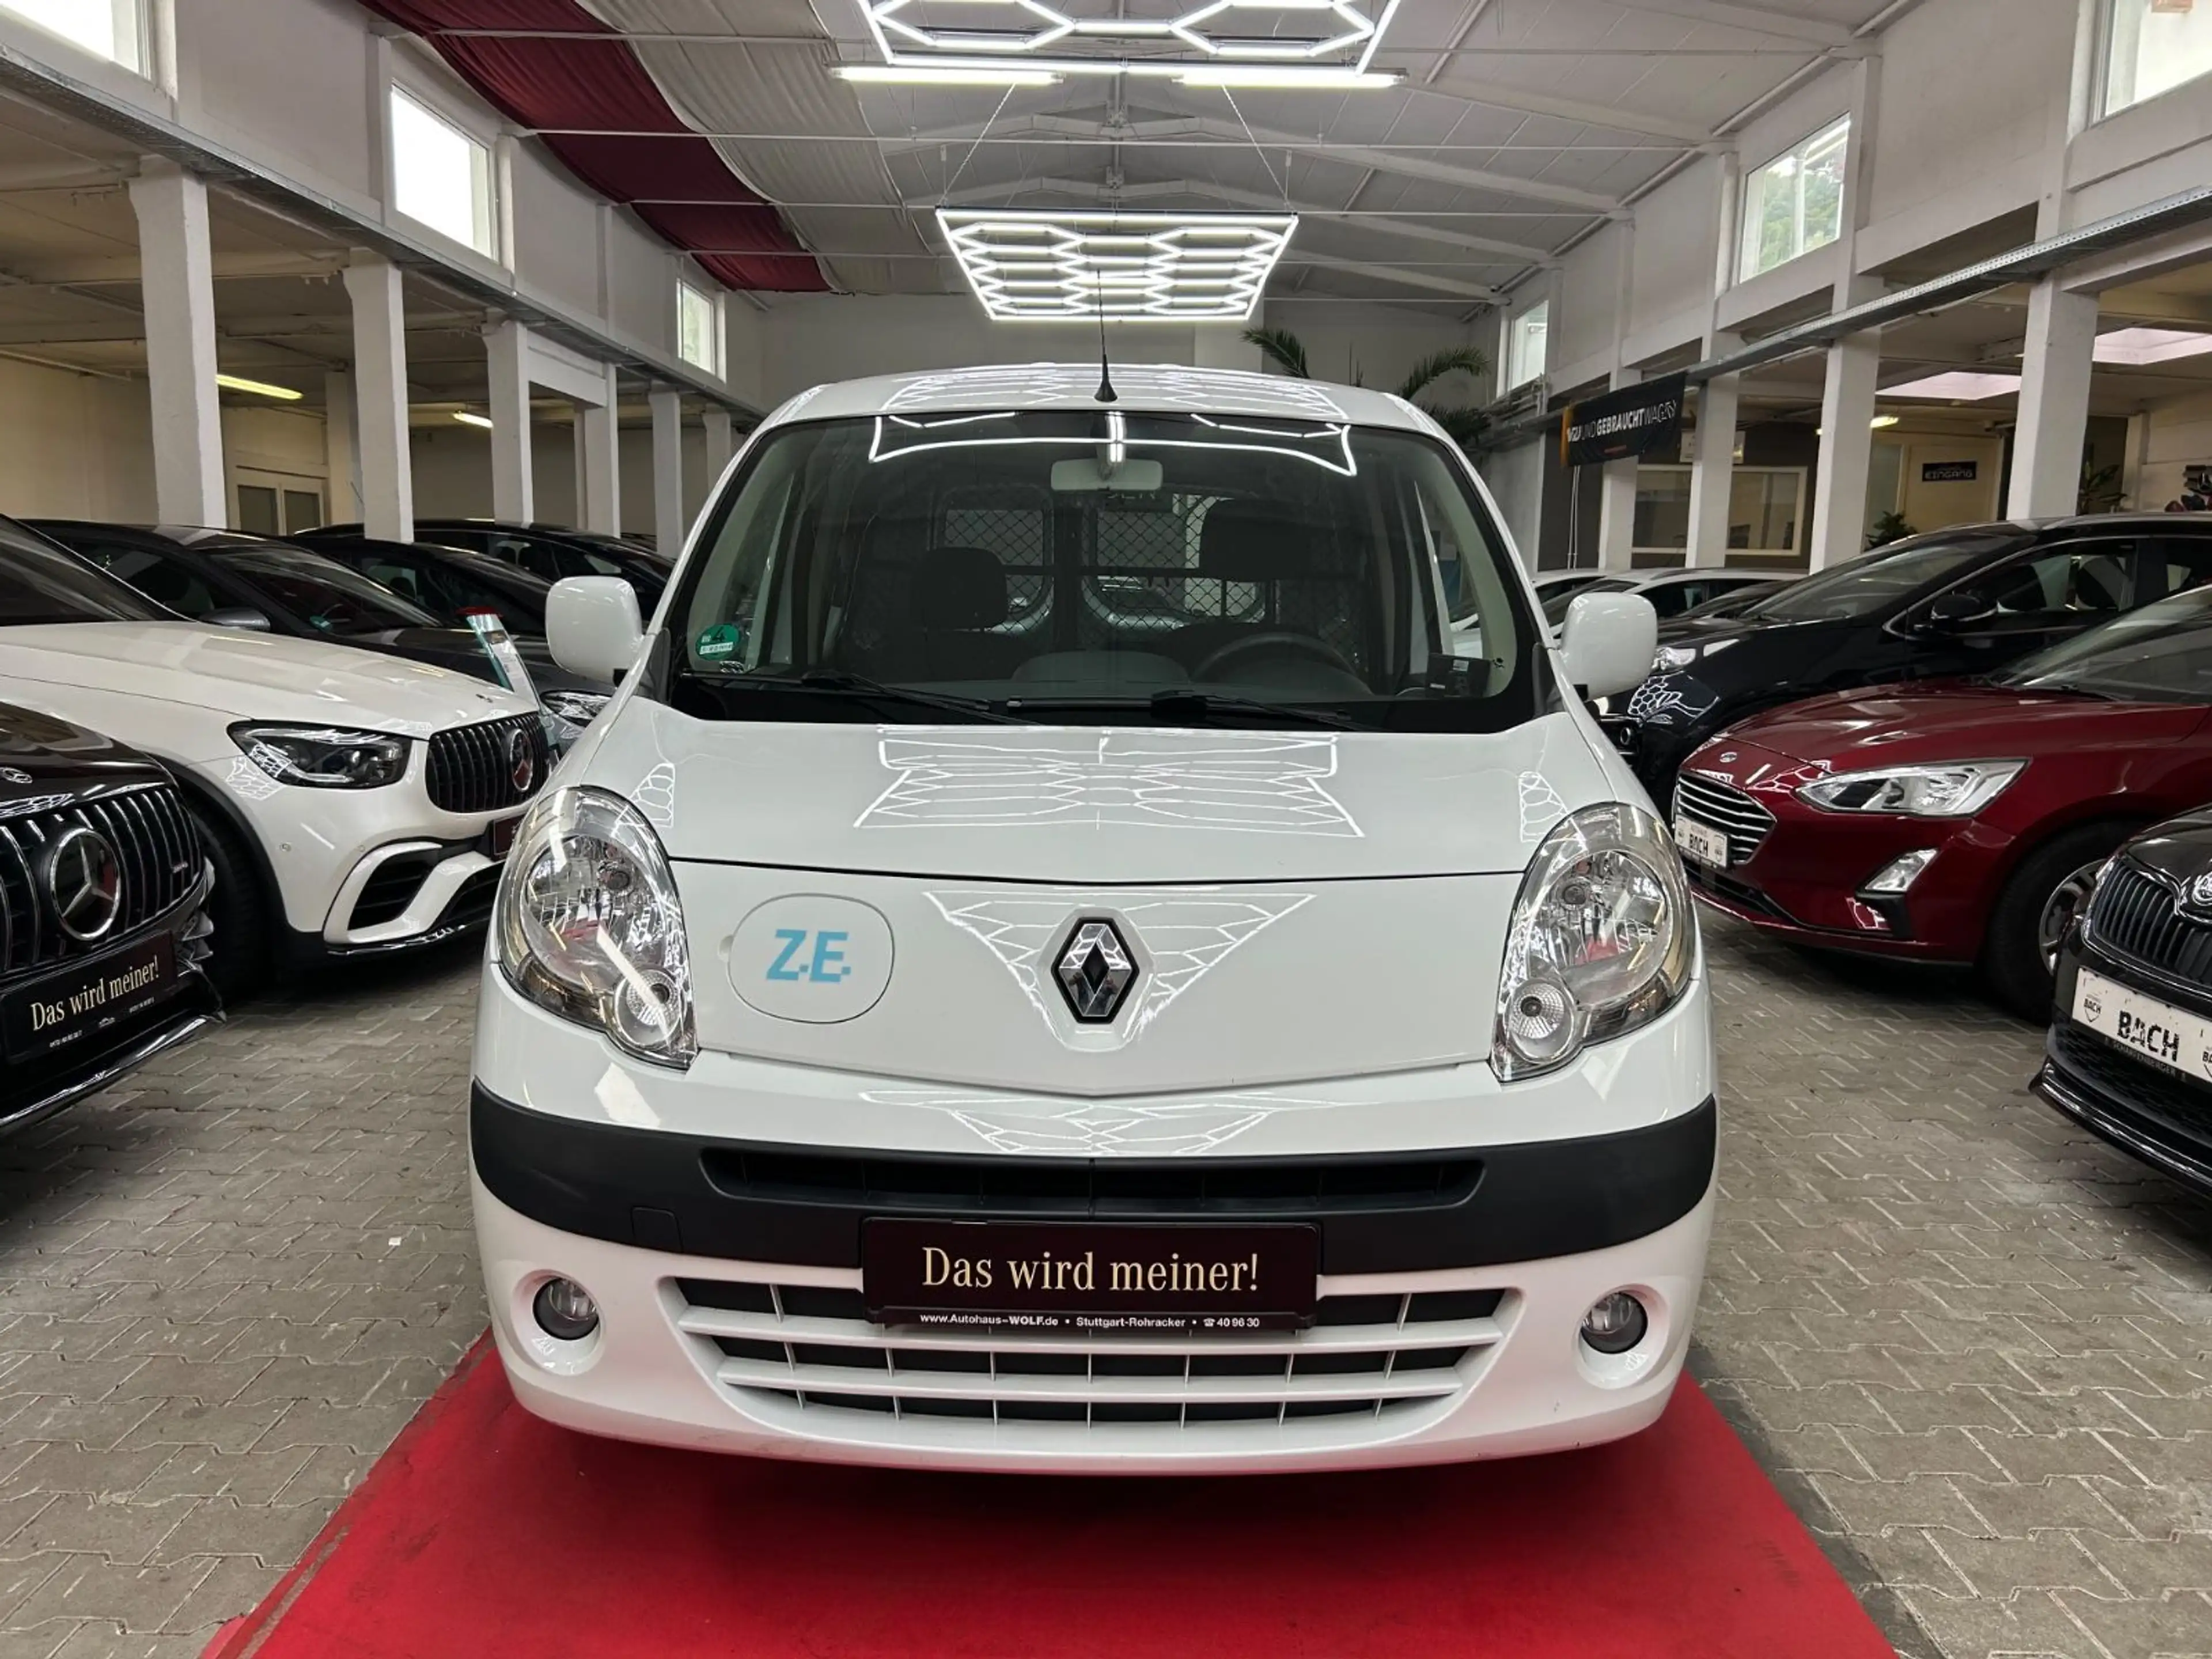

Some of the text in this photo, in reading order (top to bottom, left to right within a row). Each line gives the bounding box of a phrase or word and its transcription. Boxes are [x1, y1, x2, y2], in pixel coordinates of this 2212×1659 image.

[766, 929, 851, 983] Z.E.
[31, 1001, 65, 1031] Das
[69, 977, 106, 1016] wird
[109, 954, 160, 999] meiner!
[2117, 1010, 2180, 1062] BACH
[922, 1247, 1258, 1291] Das wird meiner!
[1076, 1317, 1185, 1328] Stuttgart-Rohracker
